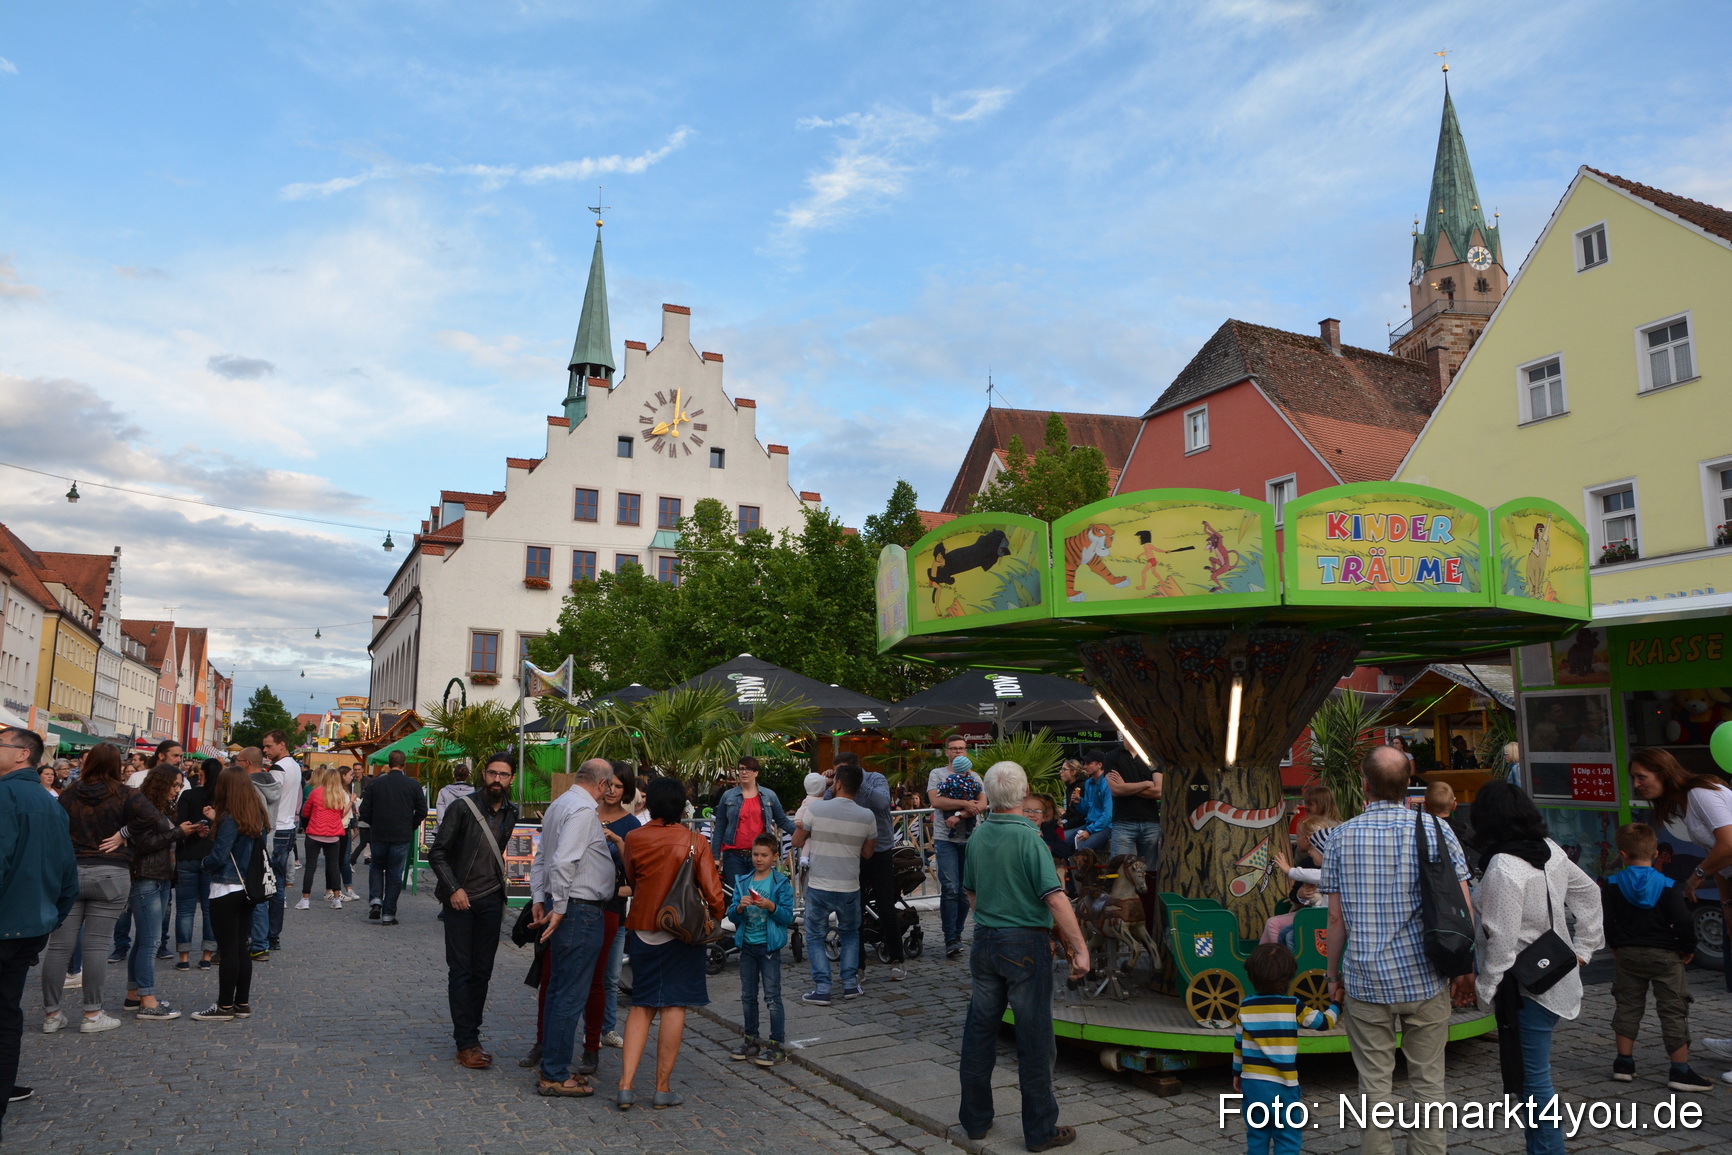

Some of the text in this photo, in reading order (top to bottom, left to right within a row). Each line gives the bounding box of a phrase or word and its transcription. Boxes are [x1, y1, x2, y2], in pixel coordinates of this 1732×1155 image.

[1326, 511, 1455, 544] KINDER
[1317, 547, 1464, 585] TRÄUME
[1626, 632, 1724, 667] KASSE
[993, 675, 1023, 697] now
